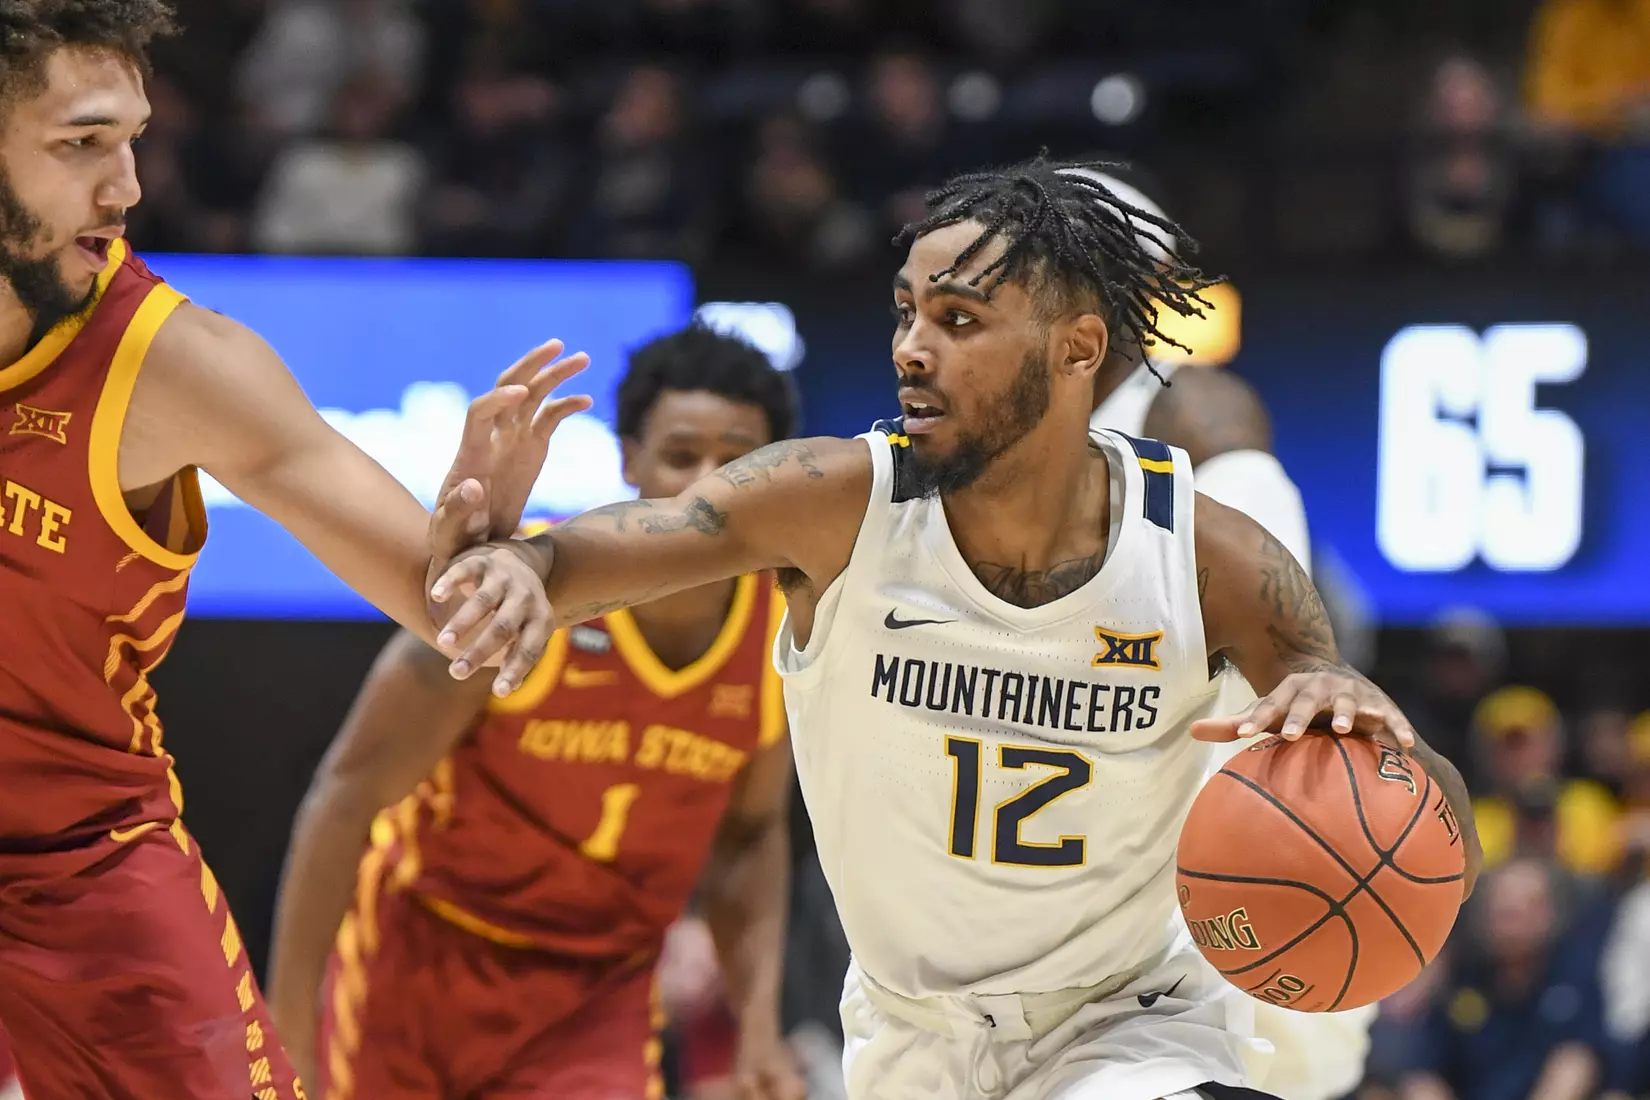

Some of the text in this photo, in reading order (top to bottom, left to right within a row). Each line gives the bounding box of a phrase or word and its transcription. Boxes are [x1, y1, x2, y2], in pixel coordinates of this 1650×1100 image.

[1375, 322, 1588, 572] 65
[0, 480, 72, 554] TE
[1092, 627, 1164, 670] XII
[871, 653, 1161, 732] MOUNTAINEERS
[518, 717, 748, 783] IOWA STATE
[578, 782, 641, 863] 1
[944, 734, 1094, 869] 12
